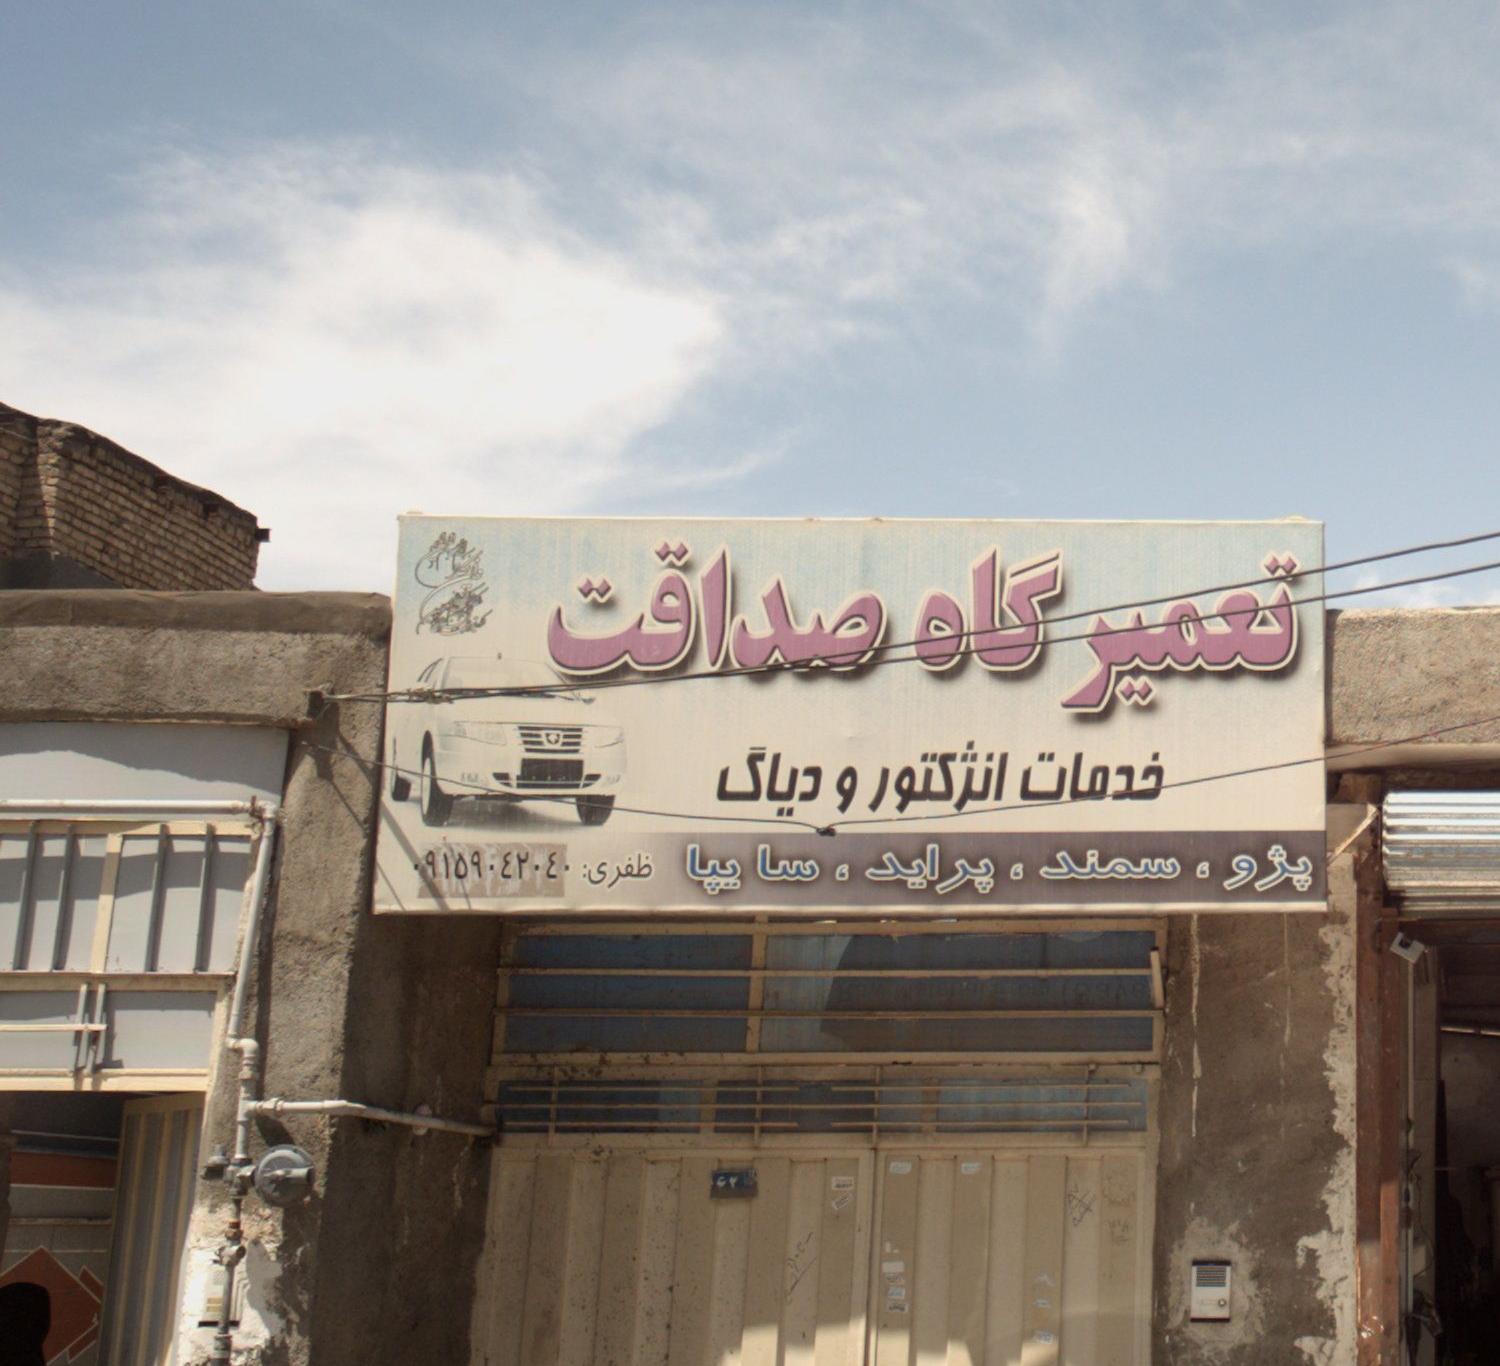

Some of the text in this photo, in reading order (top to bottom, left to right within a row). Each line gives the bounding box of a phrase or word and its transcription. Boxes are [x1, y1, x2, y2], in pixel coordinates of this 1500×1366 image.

[547, 540, 889, 673] صداقت
[716, 740, 1165, 817] خدمات انژکتور و دیاگ
[1039, 848, 1181, 880] سمند
[1224, 844, 1314, 892] پژو
